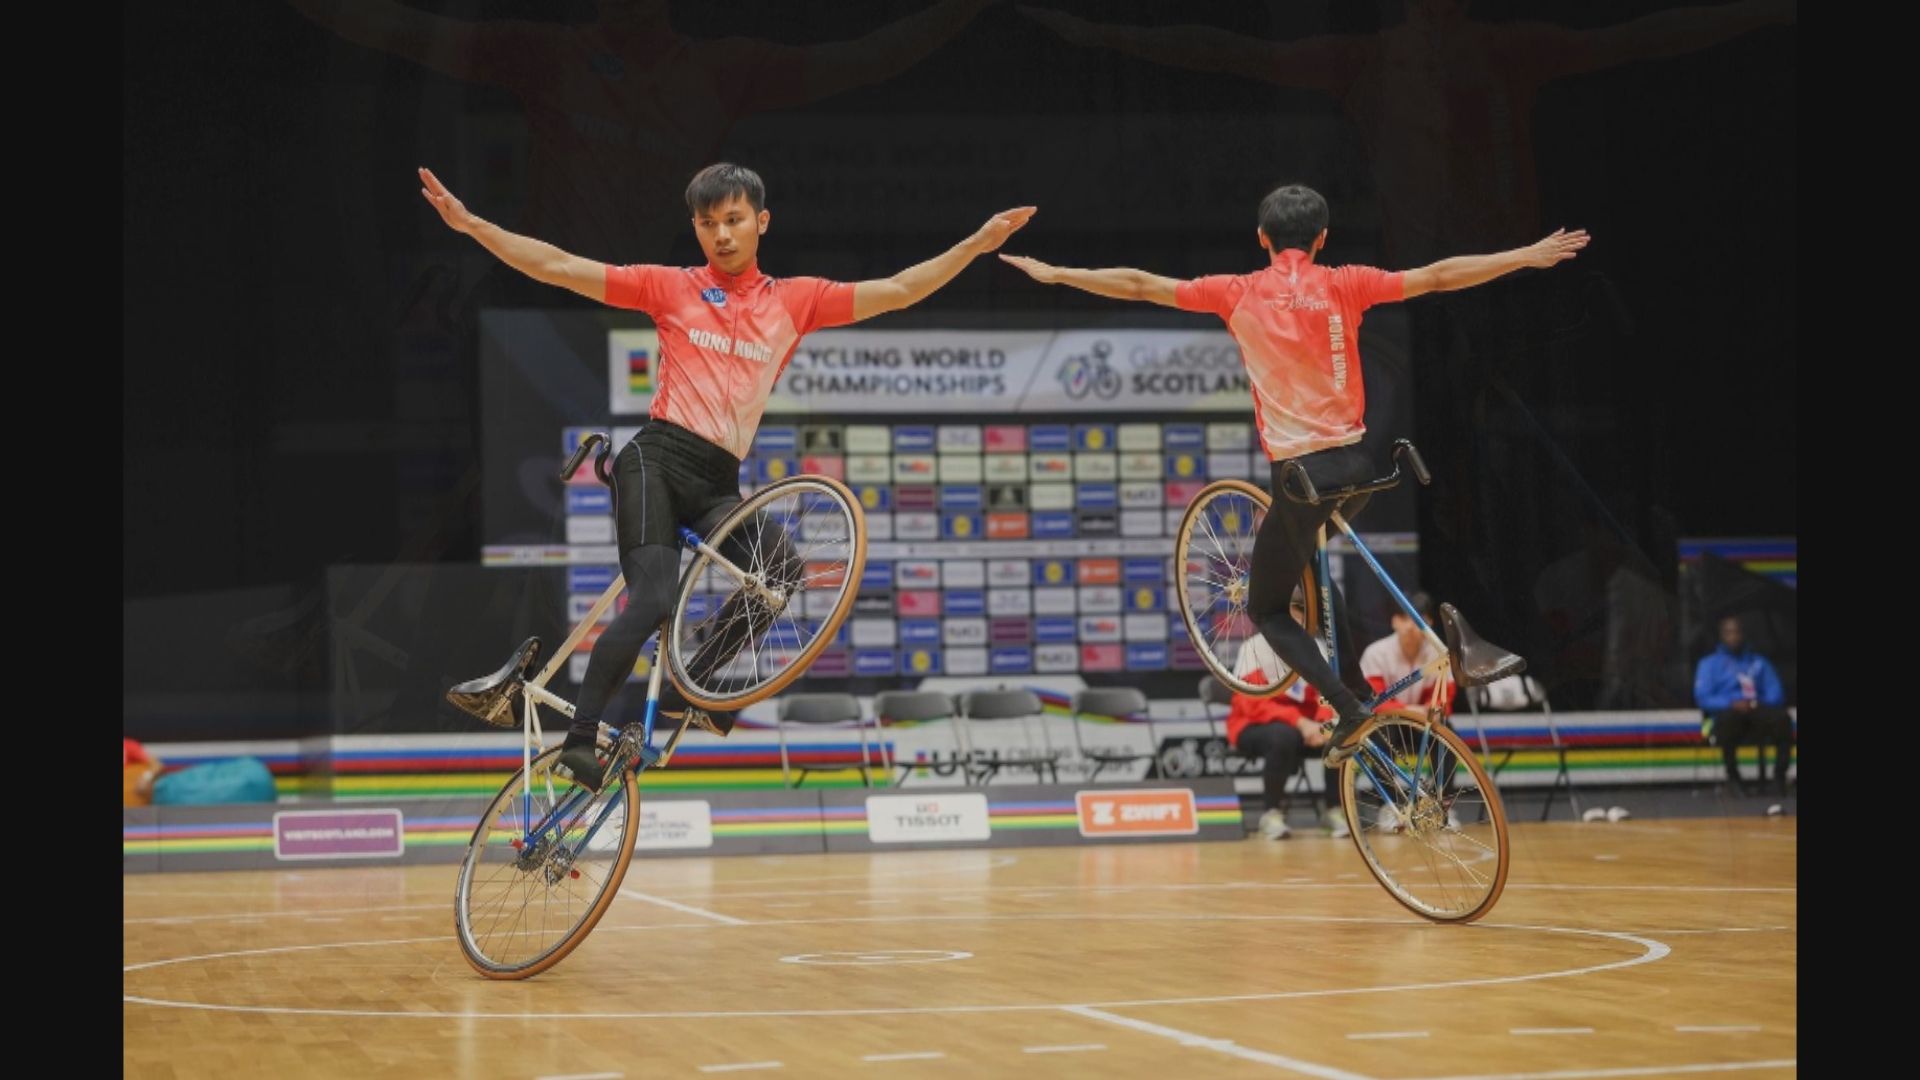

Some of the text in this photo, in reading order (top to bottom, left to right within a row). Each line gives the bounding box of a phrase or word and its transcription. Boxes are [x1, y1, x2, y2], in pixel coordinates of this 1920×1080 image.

[688, 328, 773, 363] HONG KONG
[1328, 313, 1347, 390] HONG KONG
[791, 347, 1006, 369] CYCLING WORLD
[1129, 346, 1243, 370] GLASGO
[788, 374, 1006, 395] CHAMPIONSHIPS
[1132, 373, 1251, 395] SCOTLAN
[895, 813, 962, 828] TISSOT
